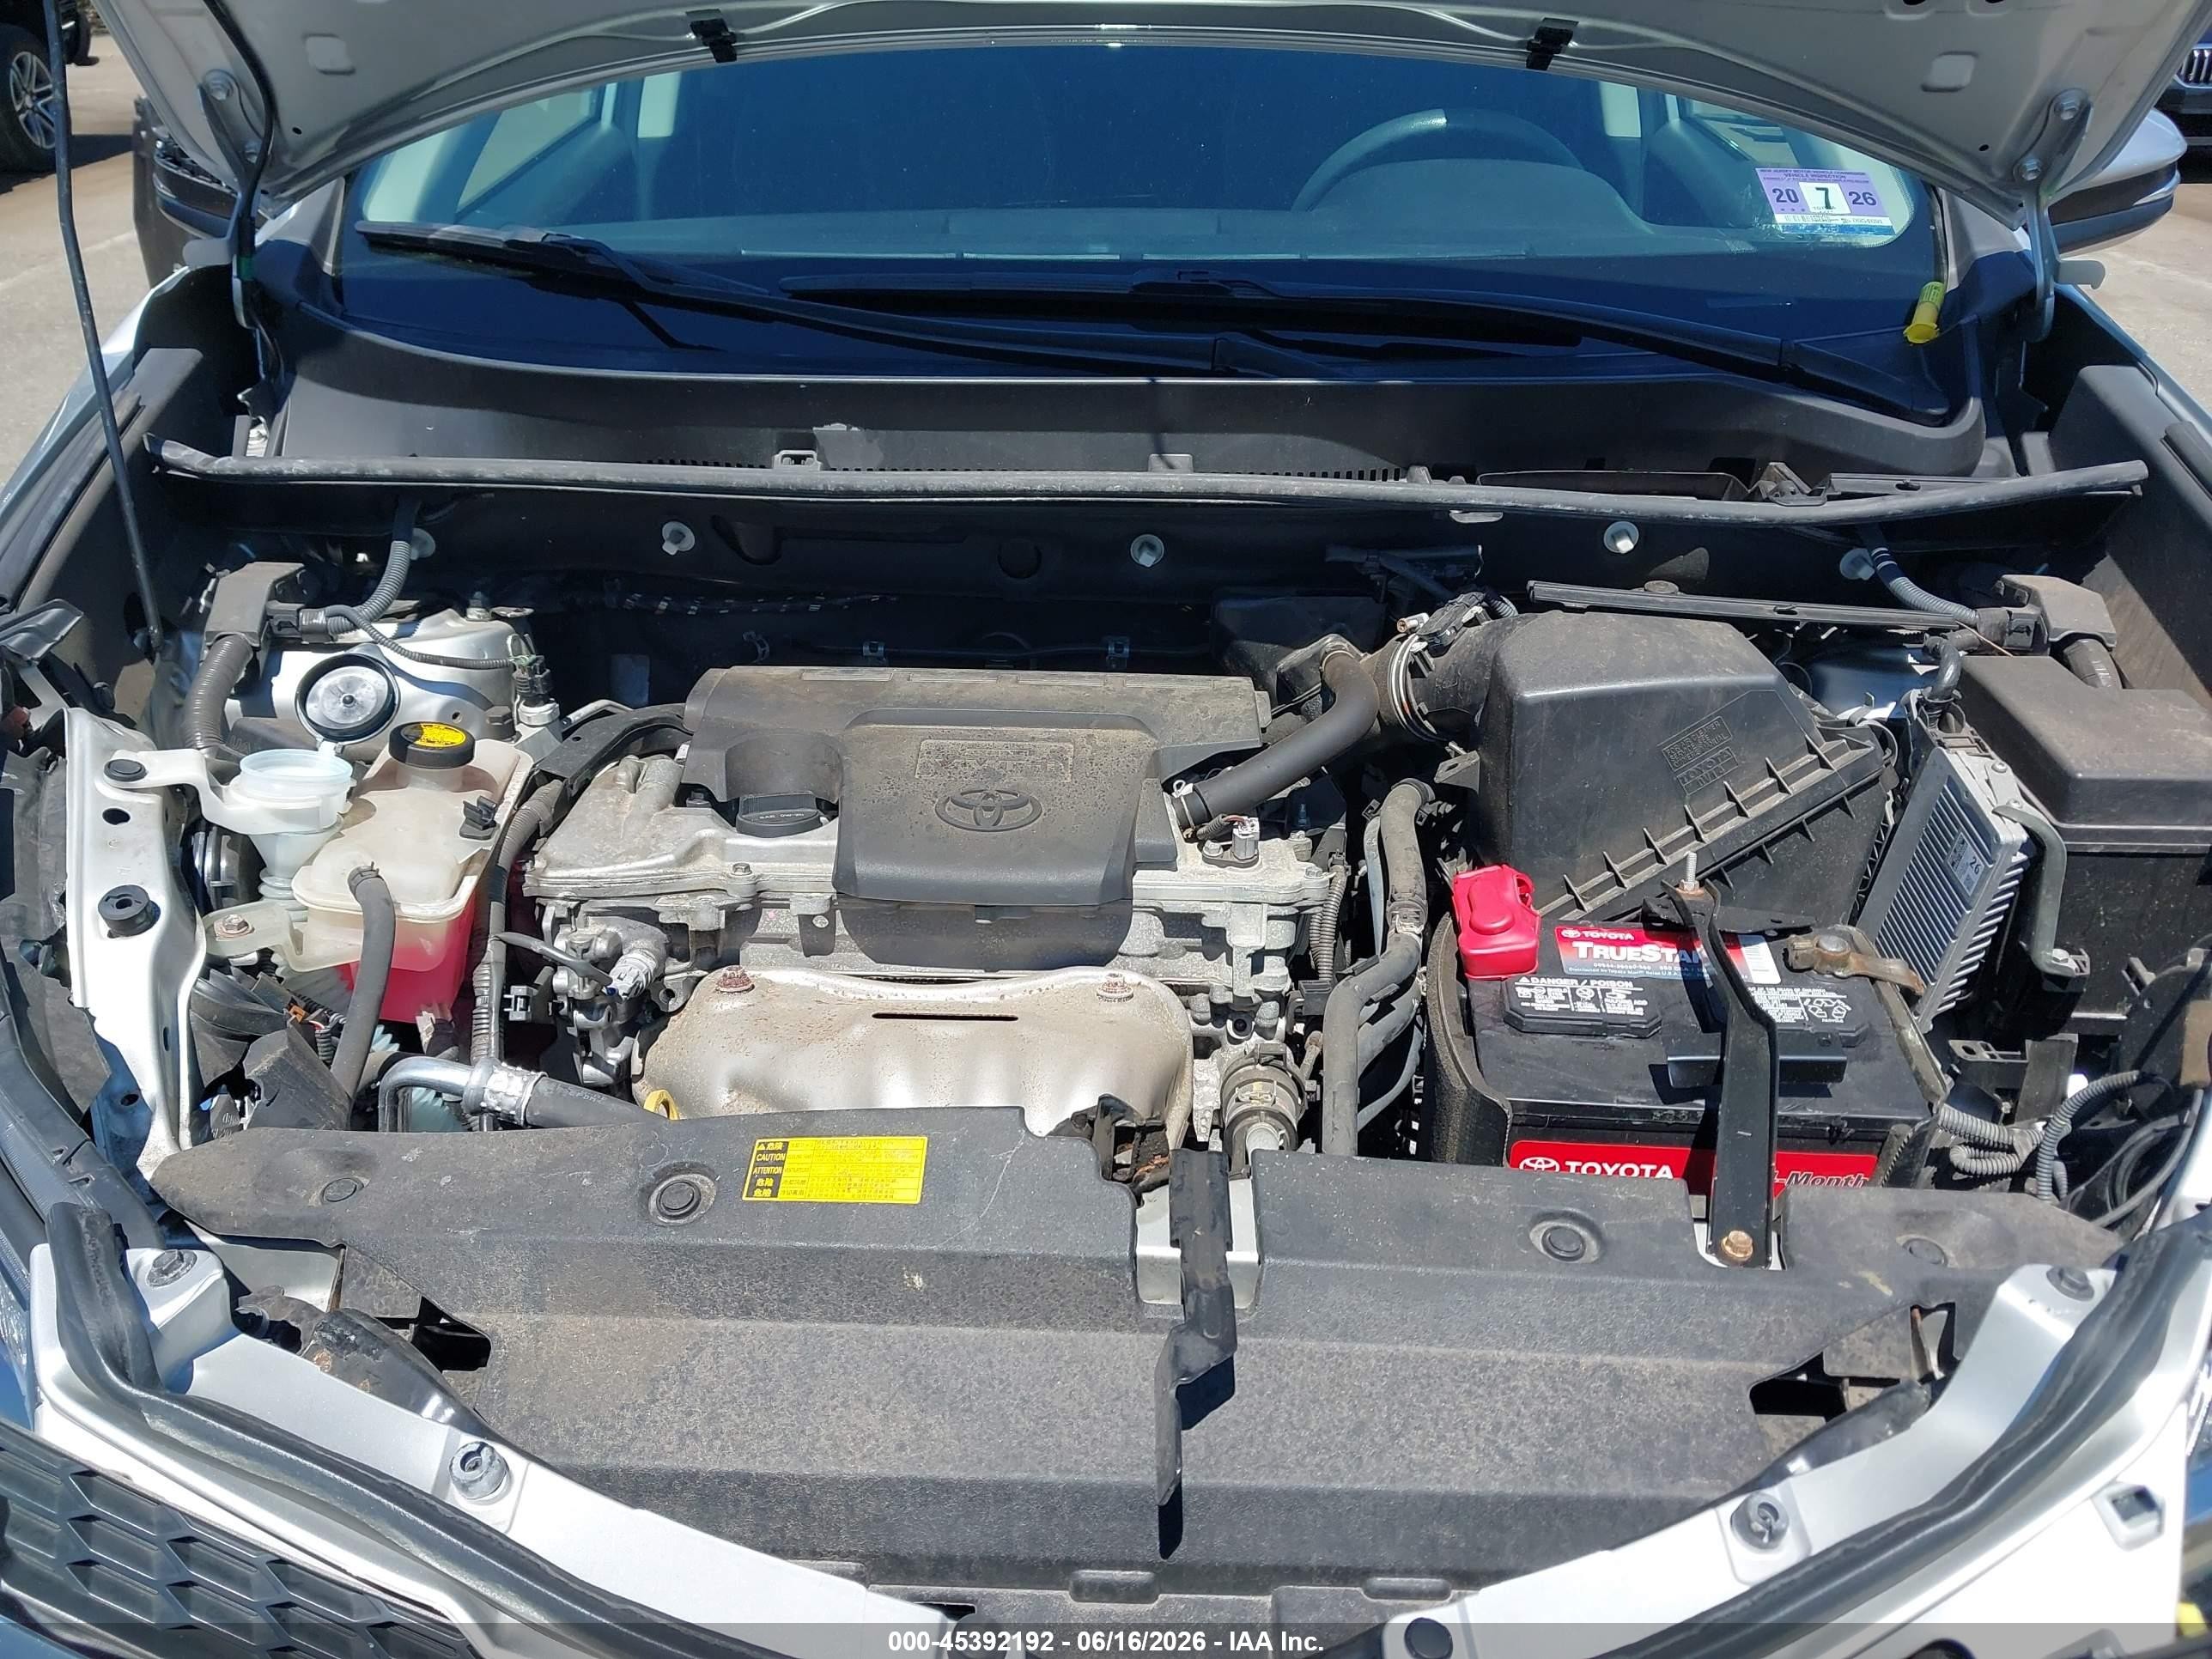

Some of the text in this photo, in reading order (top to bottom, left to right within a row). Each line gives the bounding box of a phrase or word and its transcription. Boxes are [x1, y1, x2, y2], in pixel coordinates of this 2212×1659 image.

[1771, 186, 1877, 210] 20 7 26
[1969, 856, 1981, 875] 26
[1582, 930, 1635, 941] TOYOTA
[1530, 976, 1579, 986] DANGER
[1589, 980, 1634, 988] POISON
[756, 1152, 786, 1162] CAUTION
[752, 1166, 782, 1175] ATTENTION
[1565, 1160, 1674, 1180] TOYOTA
